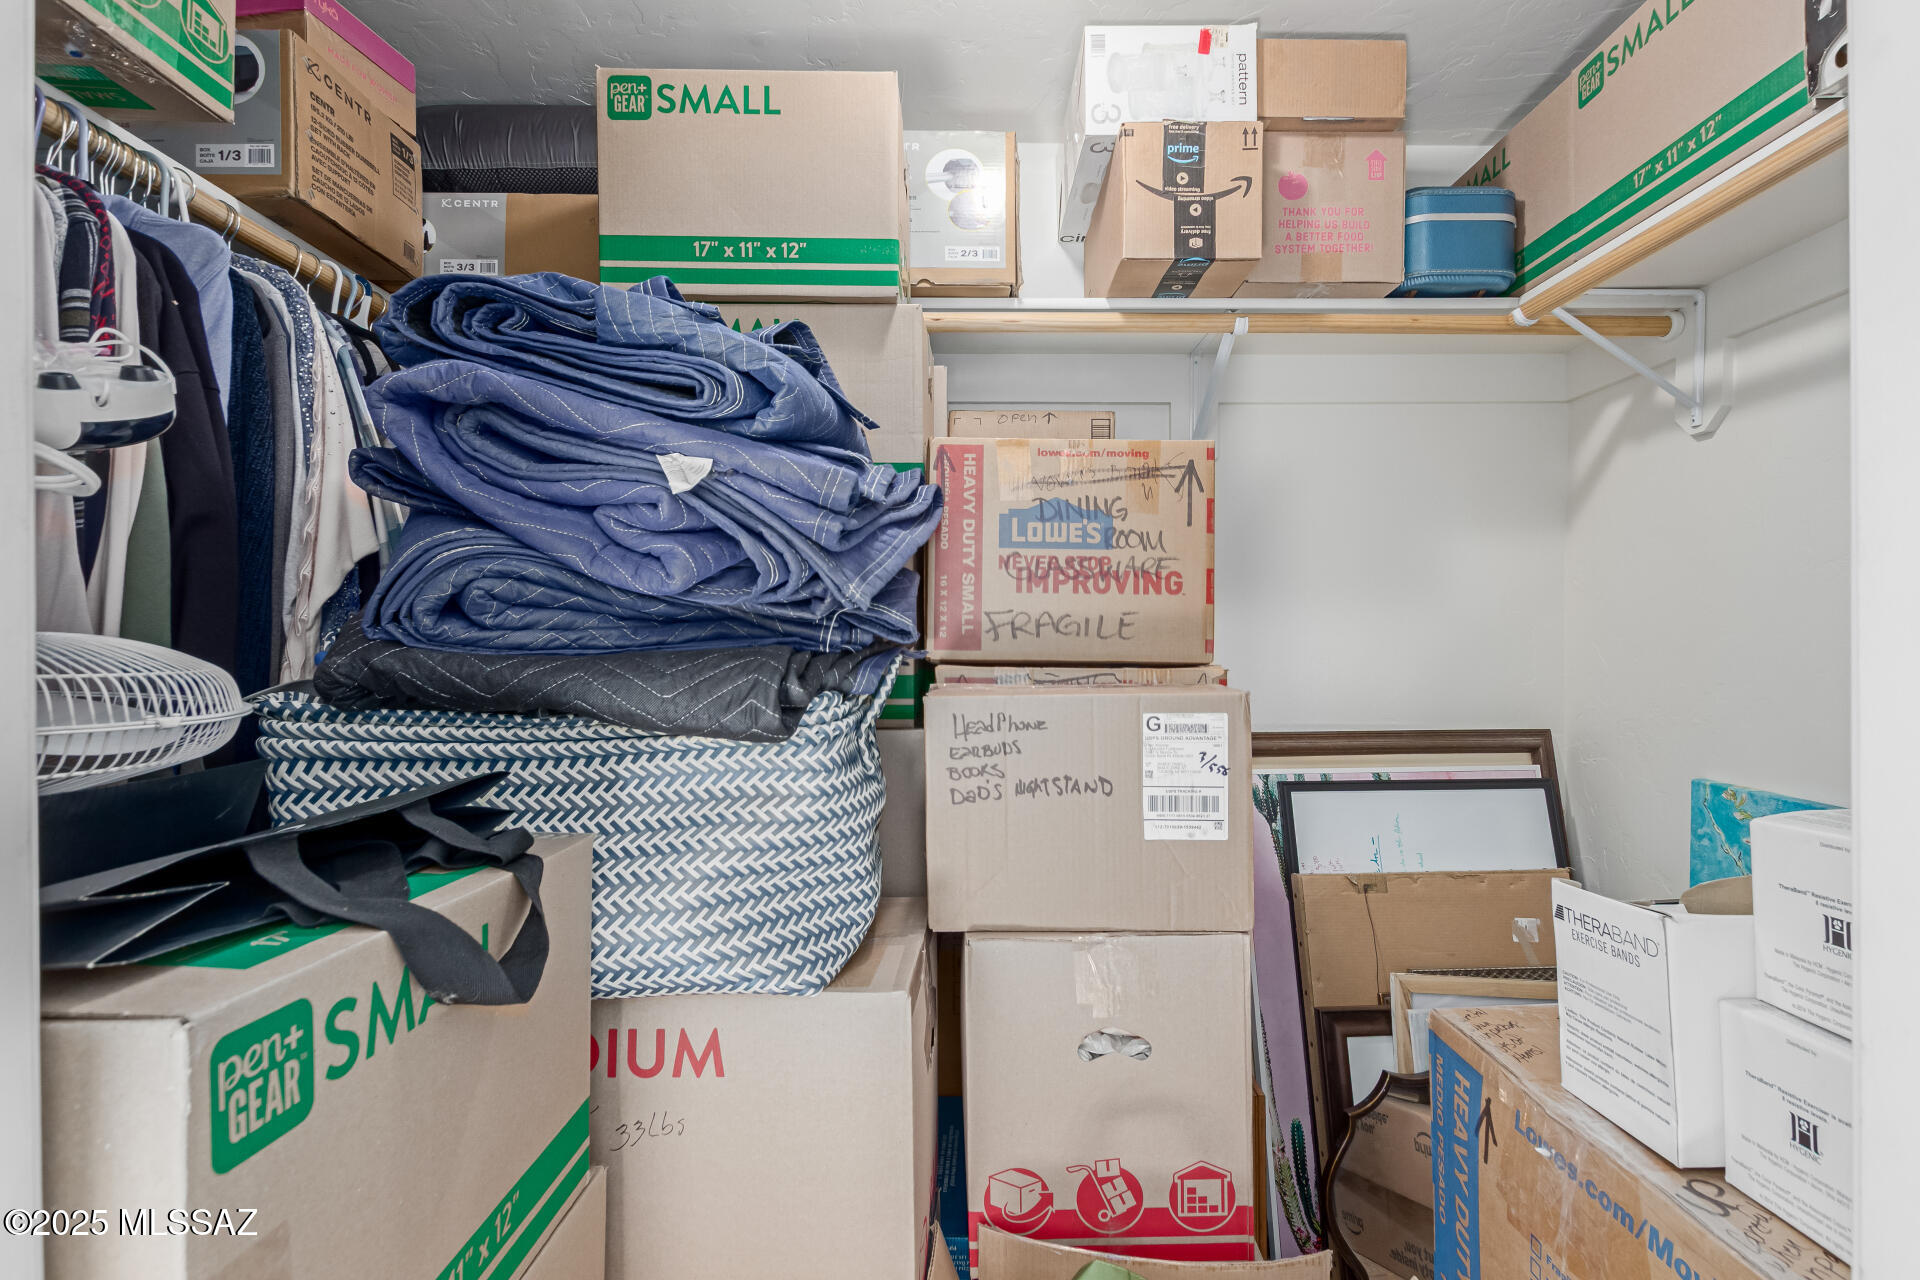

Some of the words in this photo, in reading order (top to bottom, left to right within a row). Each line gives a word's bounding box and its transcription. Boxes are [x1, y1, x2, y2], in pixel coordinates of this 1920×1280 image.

[1235, 53, 1249, 105] pattern
[324, 74, 372, 126] CENTR
[656, 83, 782, 115] SMALL
[1167, 142, 1200, 154] prime
[1667, 141, 1684, 166] 11"
[1699, 113, 1722, 144] 12"
[218, 149, 242, 162] 1/3
[454, 199, 499, 208] CENTR
[1282, 207, 1317, 217] THANK
[1321, 207, 1340, 217] YOU
[1344, 207, 1364, 217] FOR
[1278, 219, 1320, 229] HELPING
[1324, 220, 1338, 230] US
[1341, 220, 1370, 230] BUILD
[1285, 231, 1293, 241] A
[1295, 231, 1334, 242] BETTER
[1337, 231, 1364, 242] FOOD
[693, 240, 719, 257] 17"
[723, 245, 735, 258] x
[739, 241, 761, 258] 11"
[765, 246, 777, 258] x
[781, 241, 807, 259] 12"
[961, 249, 978, 258] 2/3
[1274, 244, 1316, 255] SYSTEM
[1319, 243, 1375, 254] TOGETHER!
[456, 263, 475, 272] 3/3
[962, 453, 977, 513] HEAVY
[1032, 495, 1128, 521] DINING
[1011, 517, 1101, 544] LOWE'S
[1105, 529, 1167, 553] ROOM
[961, 518, 976, 568] DUTY
[998, 555, 1052, 570] NEVER
[1053, 555, 1112, 570] STOP
[940, 575, 948, 586] 16
[940, 588, 948, 596] X
[1015, 568, 1184, 595] IMPROVING
[940, 600, 948, 613] 12
[961, 572, 975, 635] SMALL
[939, 615, 947, 623] X
[984, 609, 1139, 642] FRAGILE
[939, 626, 948, 638] 12
[1146, 716, 1161, 732] G
[946, 763, 1006, 781] BOOKS
[1564, 906, 1659, 958] THERABAND
[1571, 928, 1608, 955] EXERCISE
[1610, 944, 1641, 968] BANDS
[218, 1023, 304, 1113] pen+
[1435, 1053, 1445, 1127] MEDIO
[1453, 1069, 1471, 1198] HEAVY
[1789, 1141, 1823, 1167] HYGENIC
[1437, 1131, 1447, 1225] PESADO
